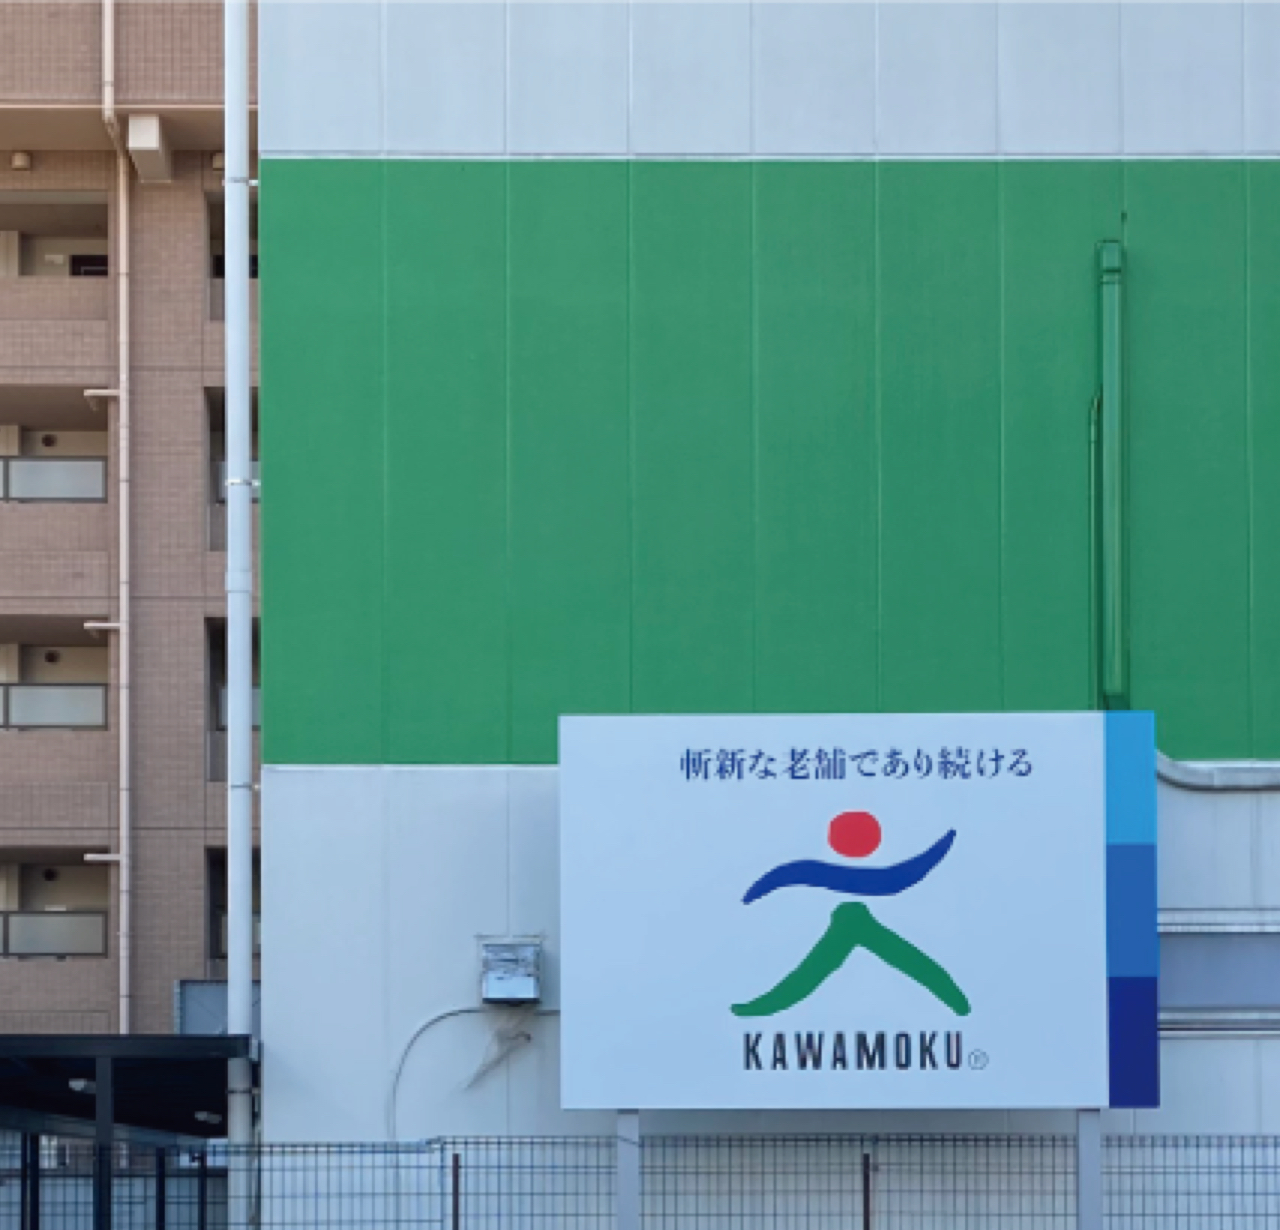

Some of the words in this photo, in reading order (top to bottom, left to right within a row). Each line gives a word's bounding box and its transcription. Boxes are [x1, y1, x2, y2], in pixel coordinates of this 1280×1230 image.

[679, 747, 1033, 782] 斬新な老舗であり続ける
[743, 1030, 963, 1071] KAWAMOKU
